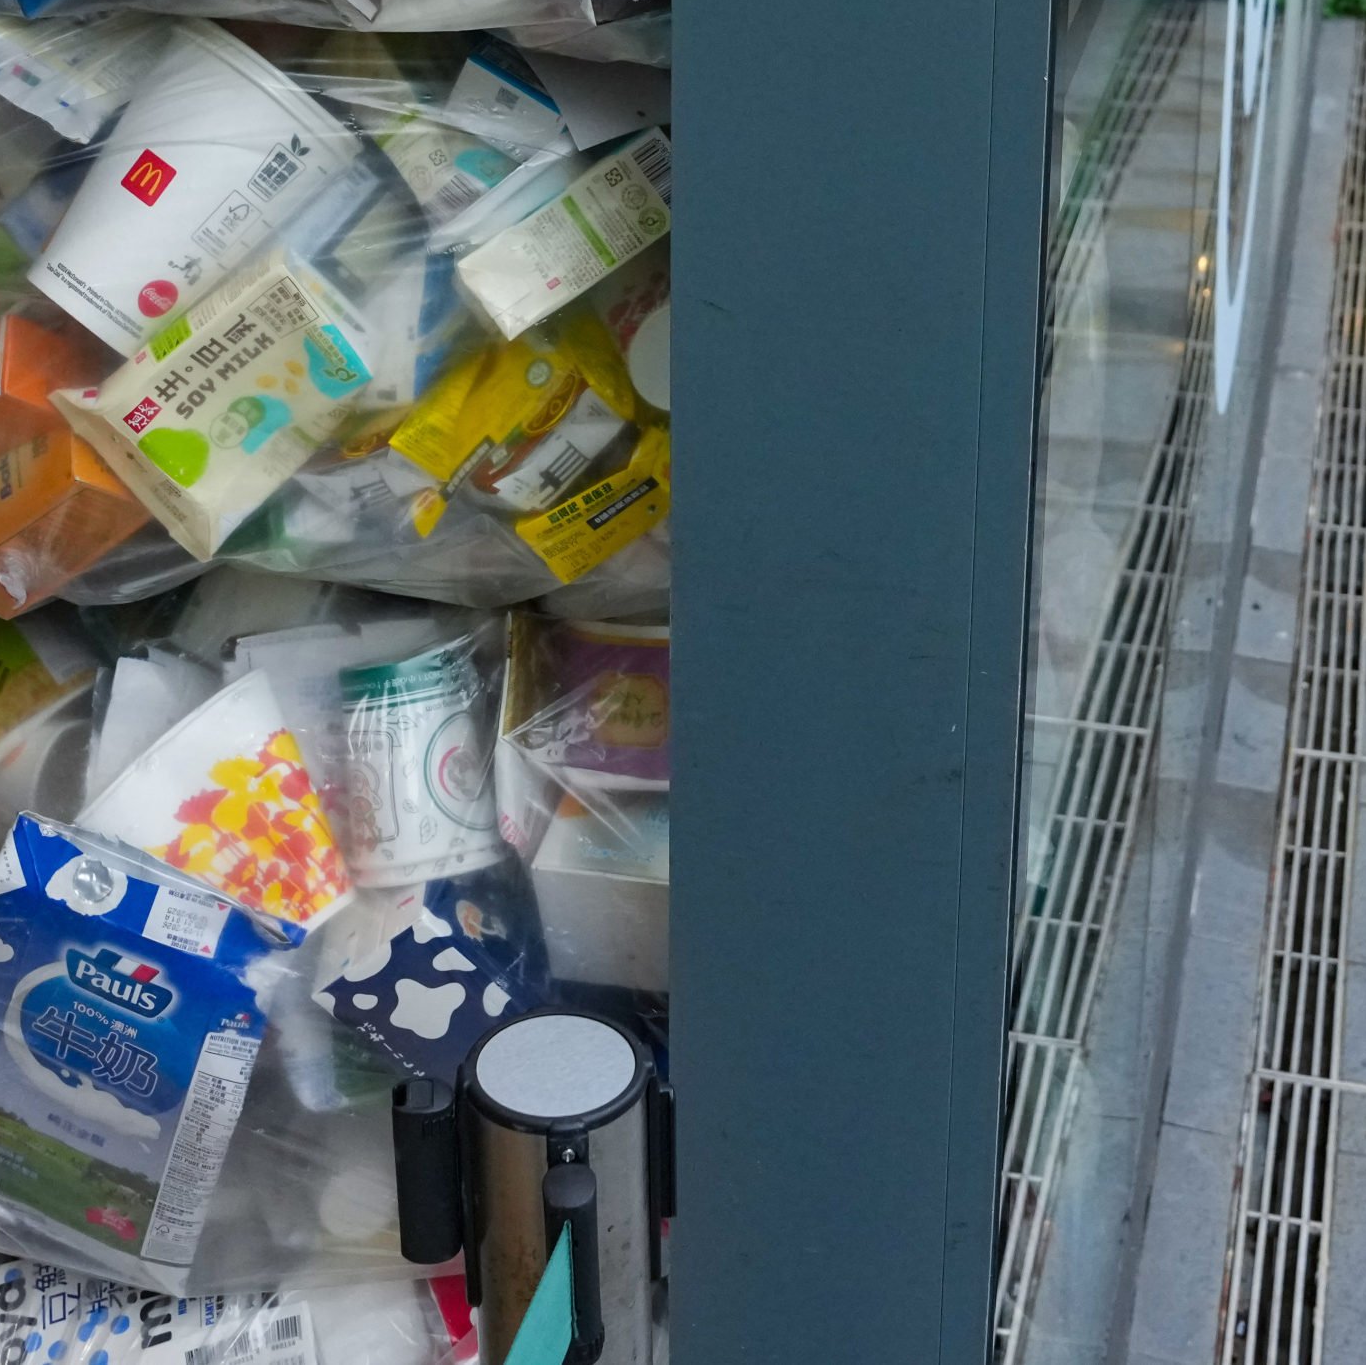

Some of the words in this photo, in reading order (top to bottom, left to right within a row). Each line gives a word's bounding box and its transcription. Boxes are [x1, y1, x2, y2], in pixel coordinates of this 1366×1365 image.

[175, 377, 217, 420] SOY
[216, 332, 276, 381] MILK
[74, 958, 156, 1012] Pauls
[72, 1000, 110, 1026] 100%
[31, 1005, 159, 1098] 牛奶
[209, 1034, 240, 1047] NUTRITION
